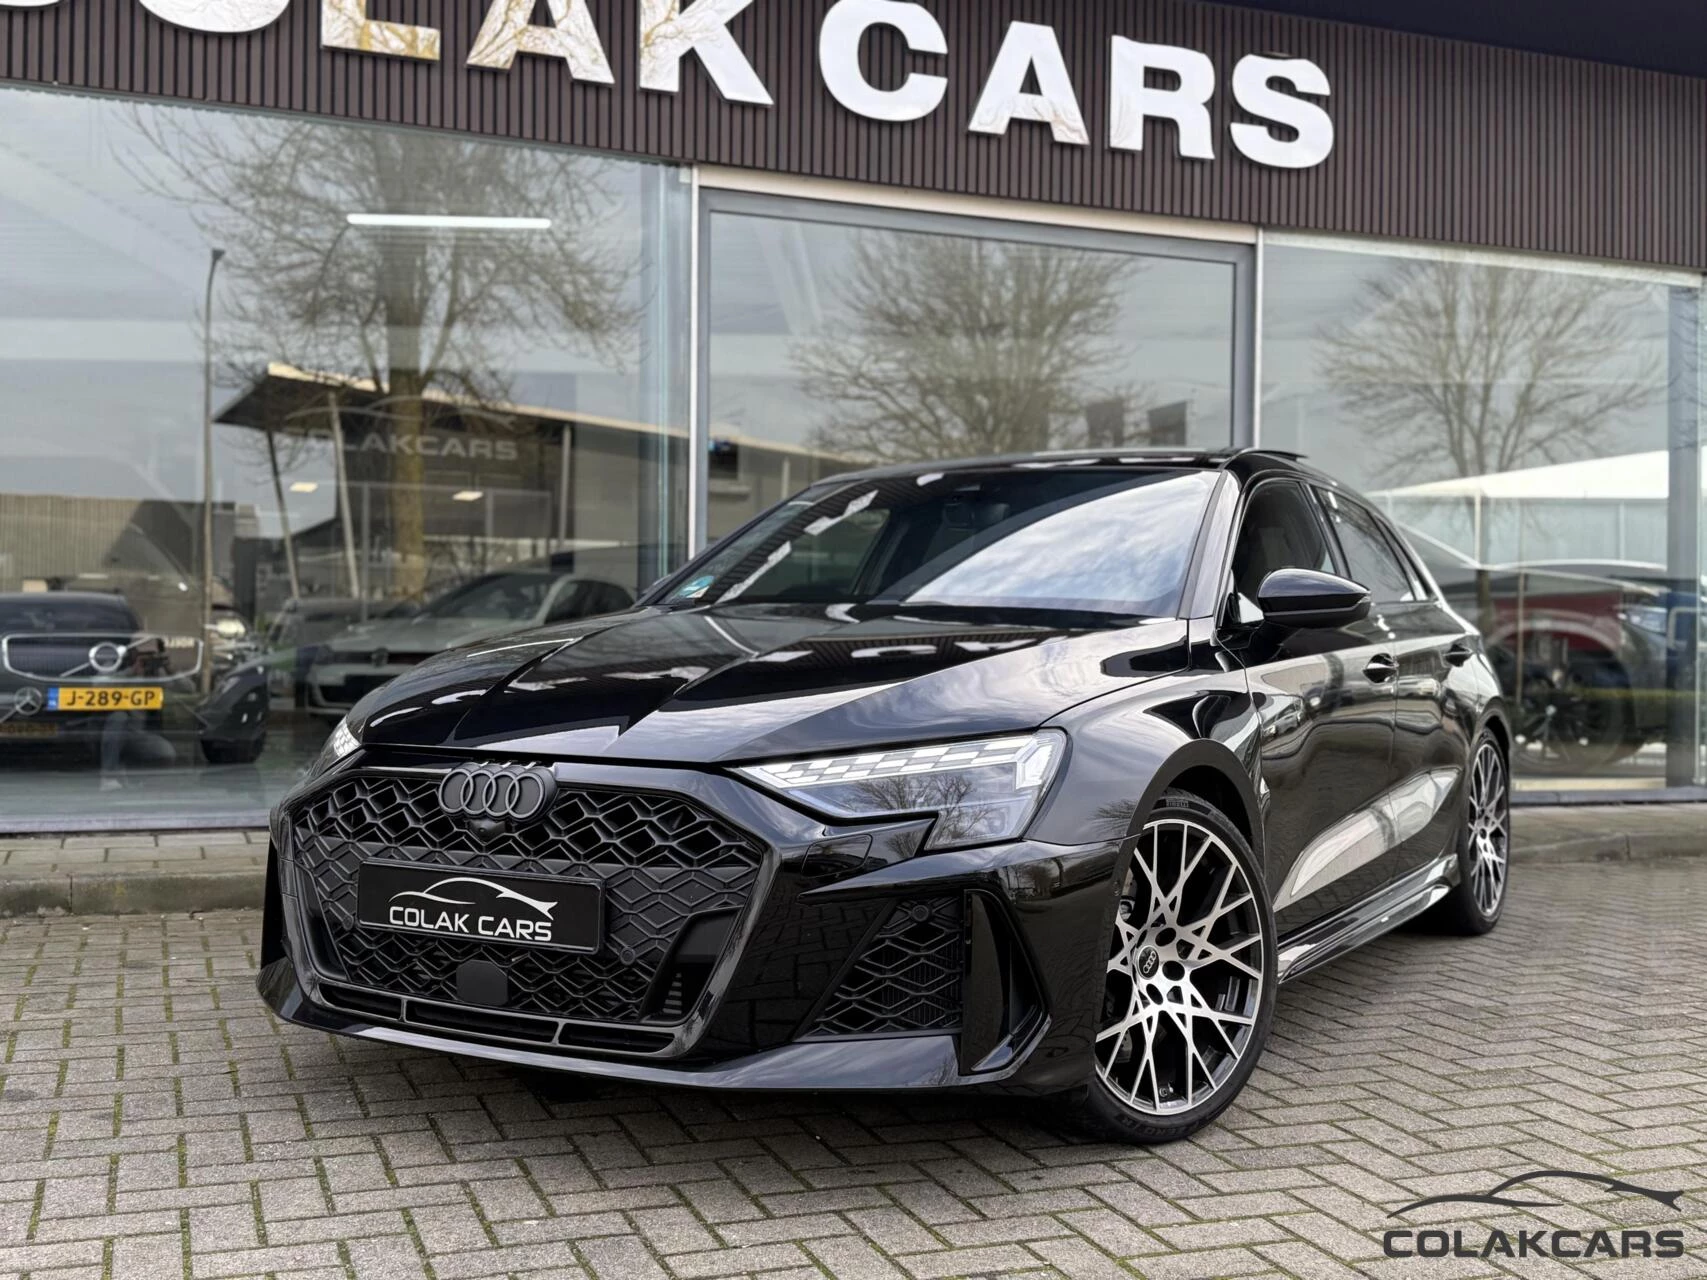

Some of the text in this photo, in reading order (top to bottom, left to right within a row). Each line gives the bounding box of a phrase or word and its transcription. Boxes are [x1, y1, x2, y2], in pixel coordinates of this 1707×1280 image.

[0, 0, 1334, 169] LAK CARS
[67, 690, 155, 706] J-289-GP
[389, 906, 552, 942] COLAK CARS
